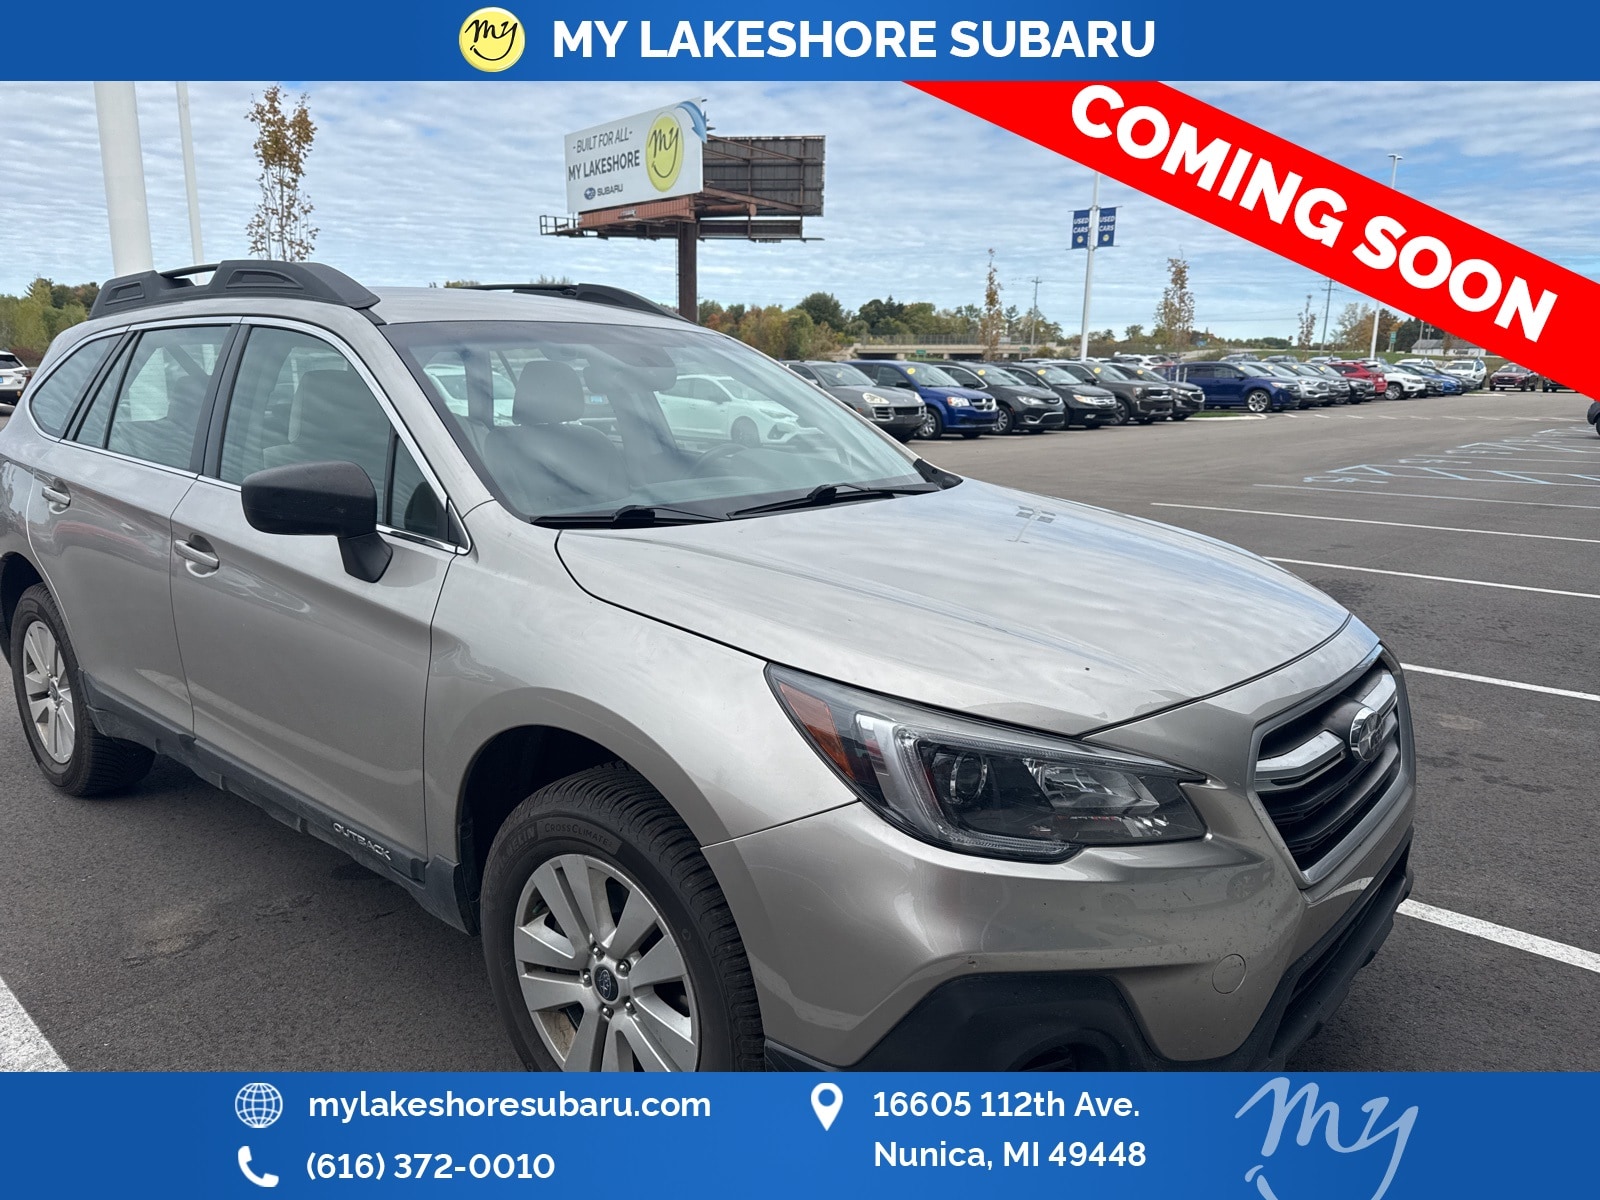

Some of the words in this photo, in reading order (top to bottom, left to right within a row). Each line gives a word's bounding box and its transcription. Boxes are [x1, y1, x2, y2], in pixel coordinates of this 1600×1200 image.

[598, 131, 614, 148] FOR
[568, 162, 582, 182] MY
[583, 150, 640, 178] LAKESHORE
[597, 184, 624, 196] SUBARU
[333, 822, 392, 861] OUTBACK
